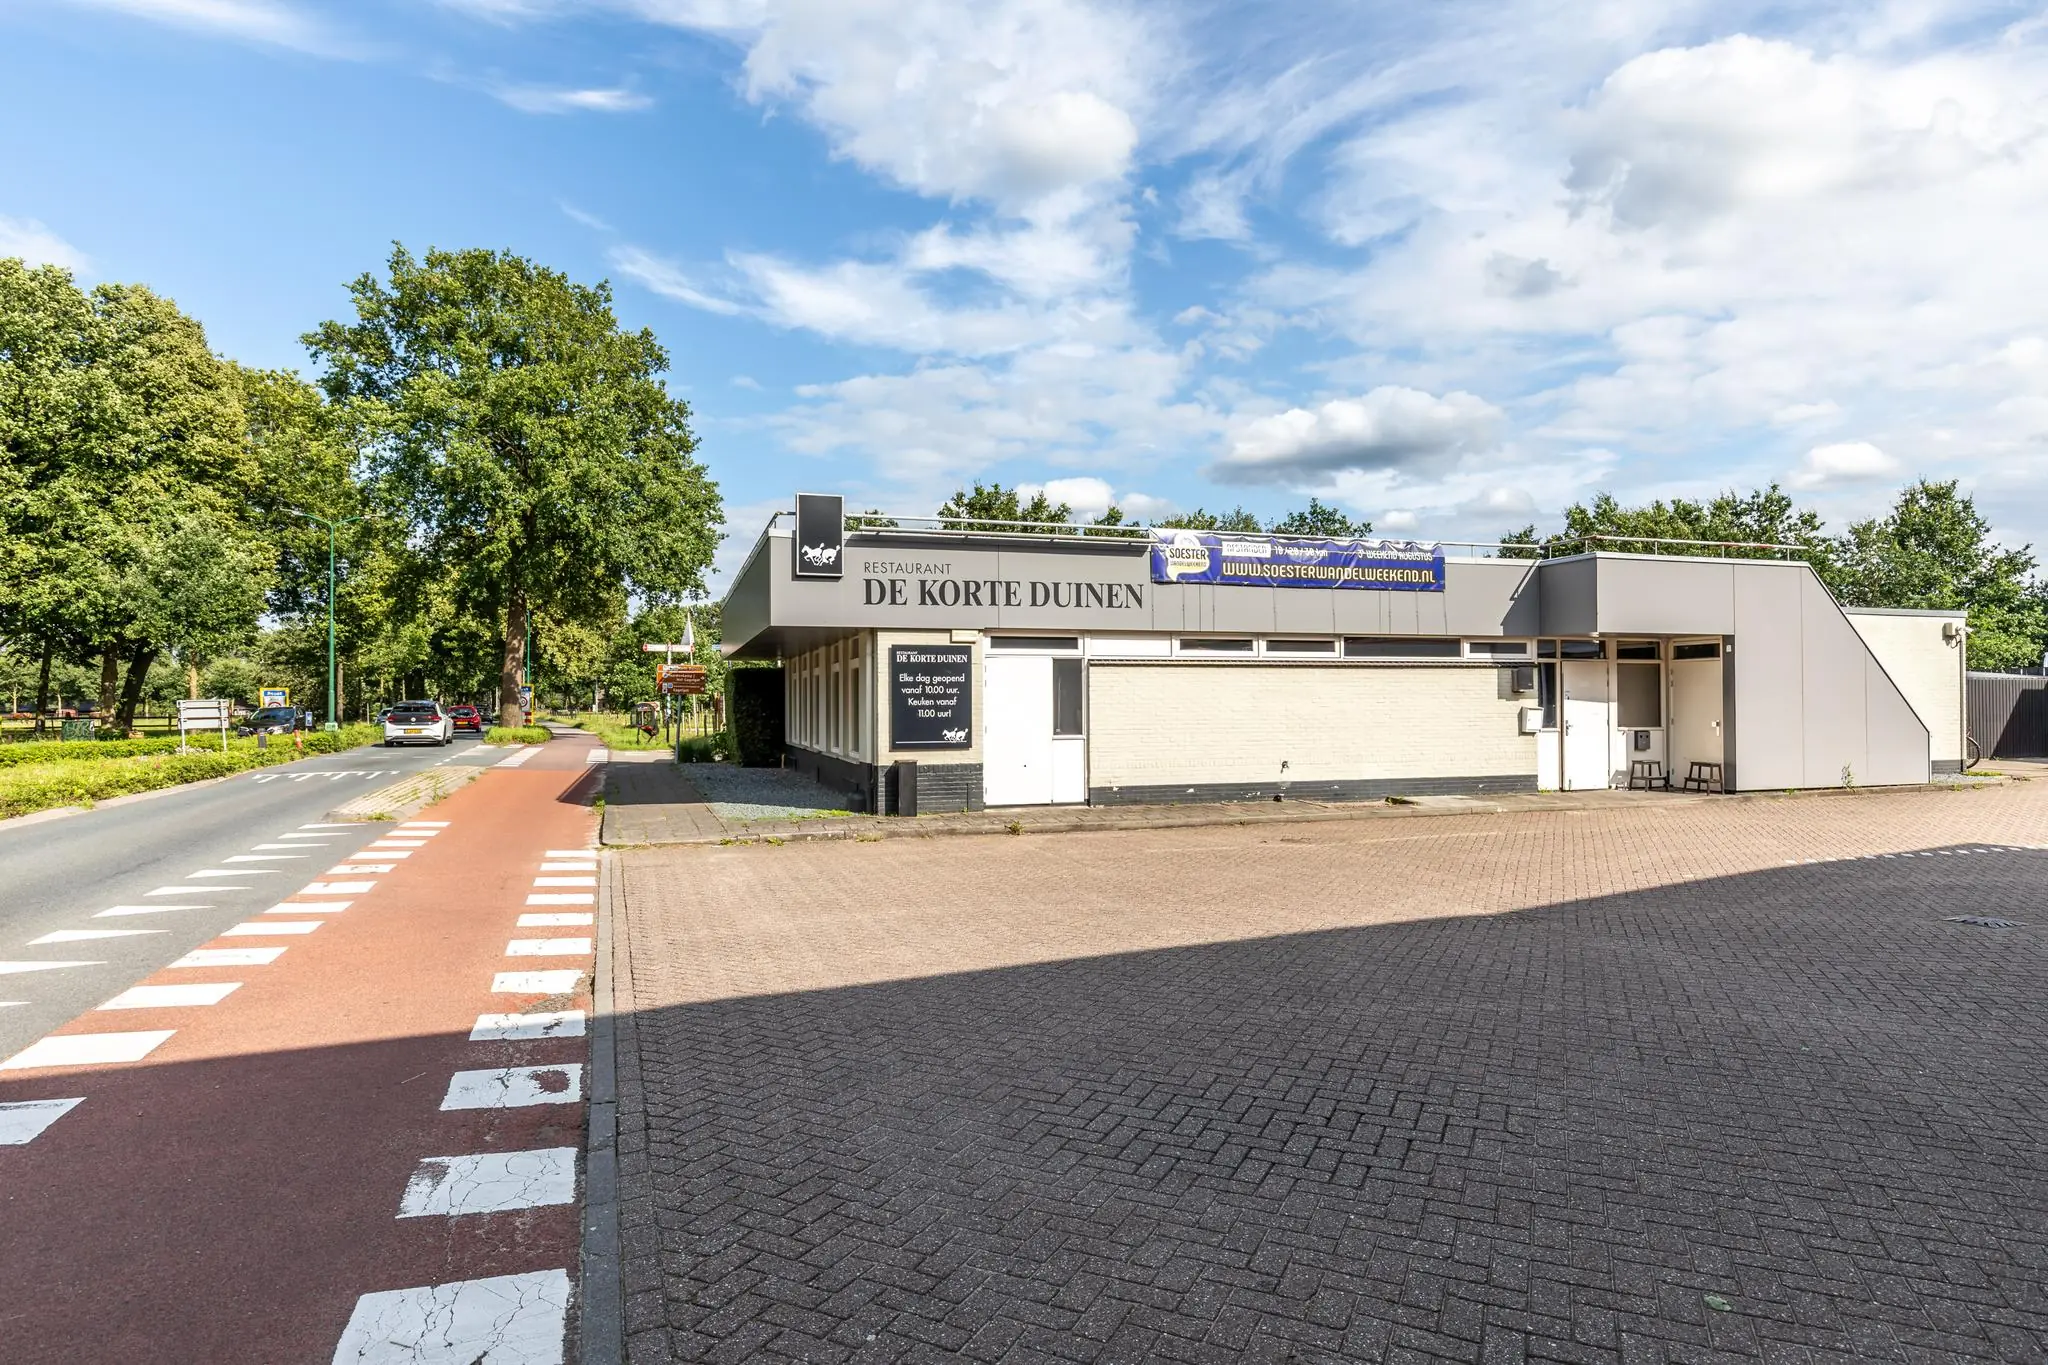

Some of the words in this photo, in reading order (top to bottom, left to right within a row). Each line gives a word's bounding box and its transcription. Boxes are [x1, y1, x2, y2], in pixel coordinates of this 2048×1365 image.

[1169, 548, 1206, 560] SOESTER
[864, 561, 952, 575] RESTAURANT
[1223, 562, 1436, 583] WWW.SOESTERWANDELWEEKEND.NL
[863, 578, 908, 606] DE
[917, 578, 1022, 607] KORTE
[1029, 581, 1144, 609] DUINEN
[896, 654, 908, 663] DE
[910, 654, 937, 663] KORTE
[937, 654, 968, 663] DUINEN
[899, 673, 914, 682] Elke
[915, 673, 931, 684] dag
[932, 673, 965, 684] geopend
[901, 685, 923, 694] vanaf
[925, 686, 945, 694] 10.00
[908, 697, 934, 706] Keuken
[936, 697, 957, 706] vanaf
[918, 709, 936, 718] 11.00
